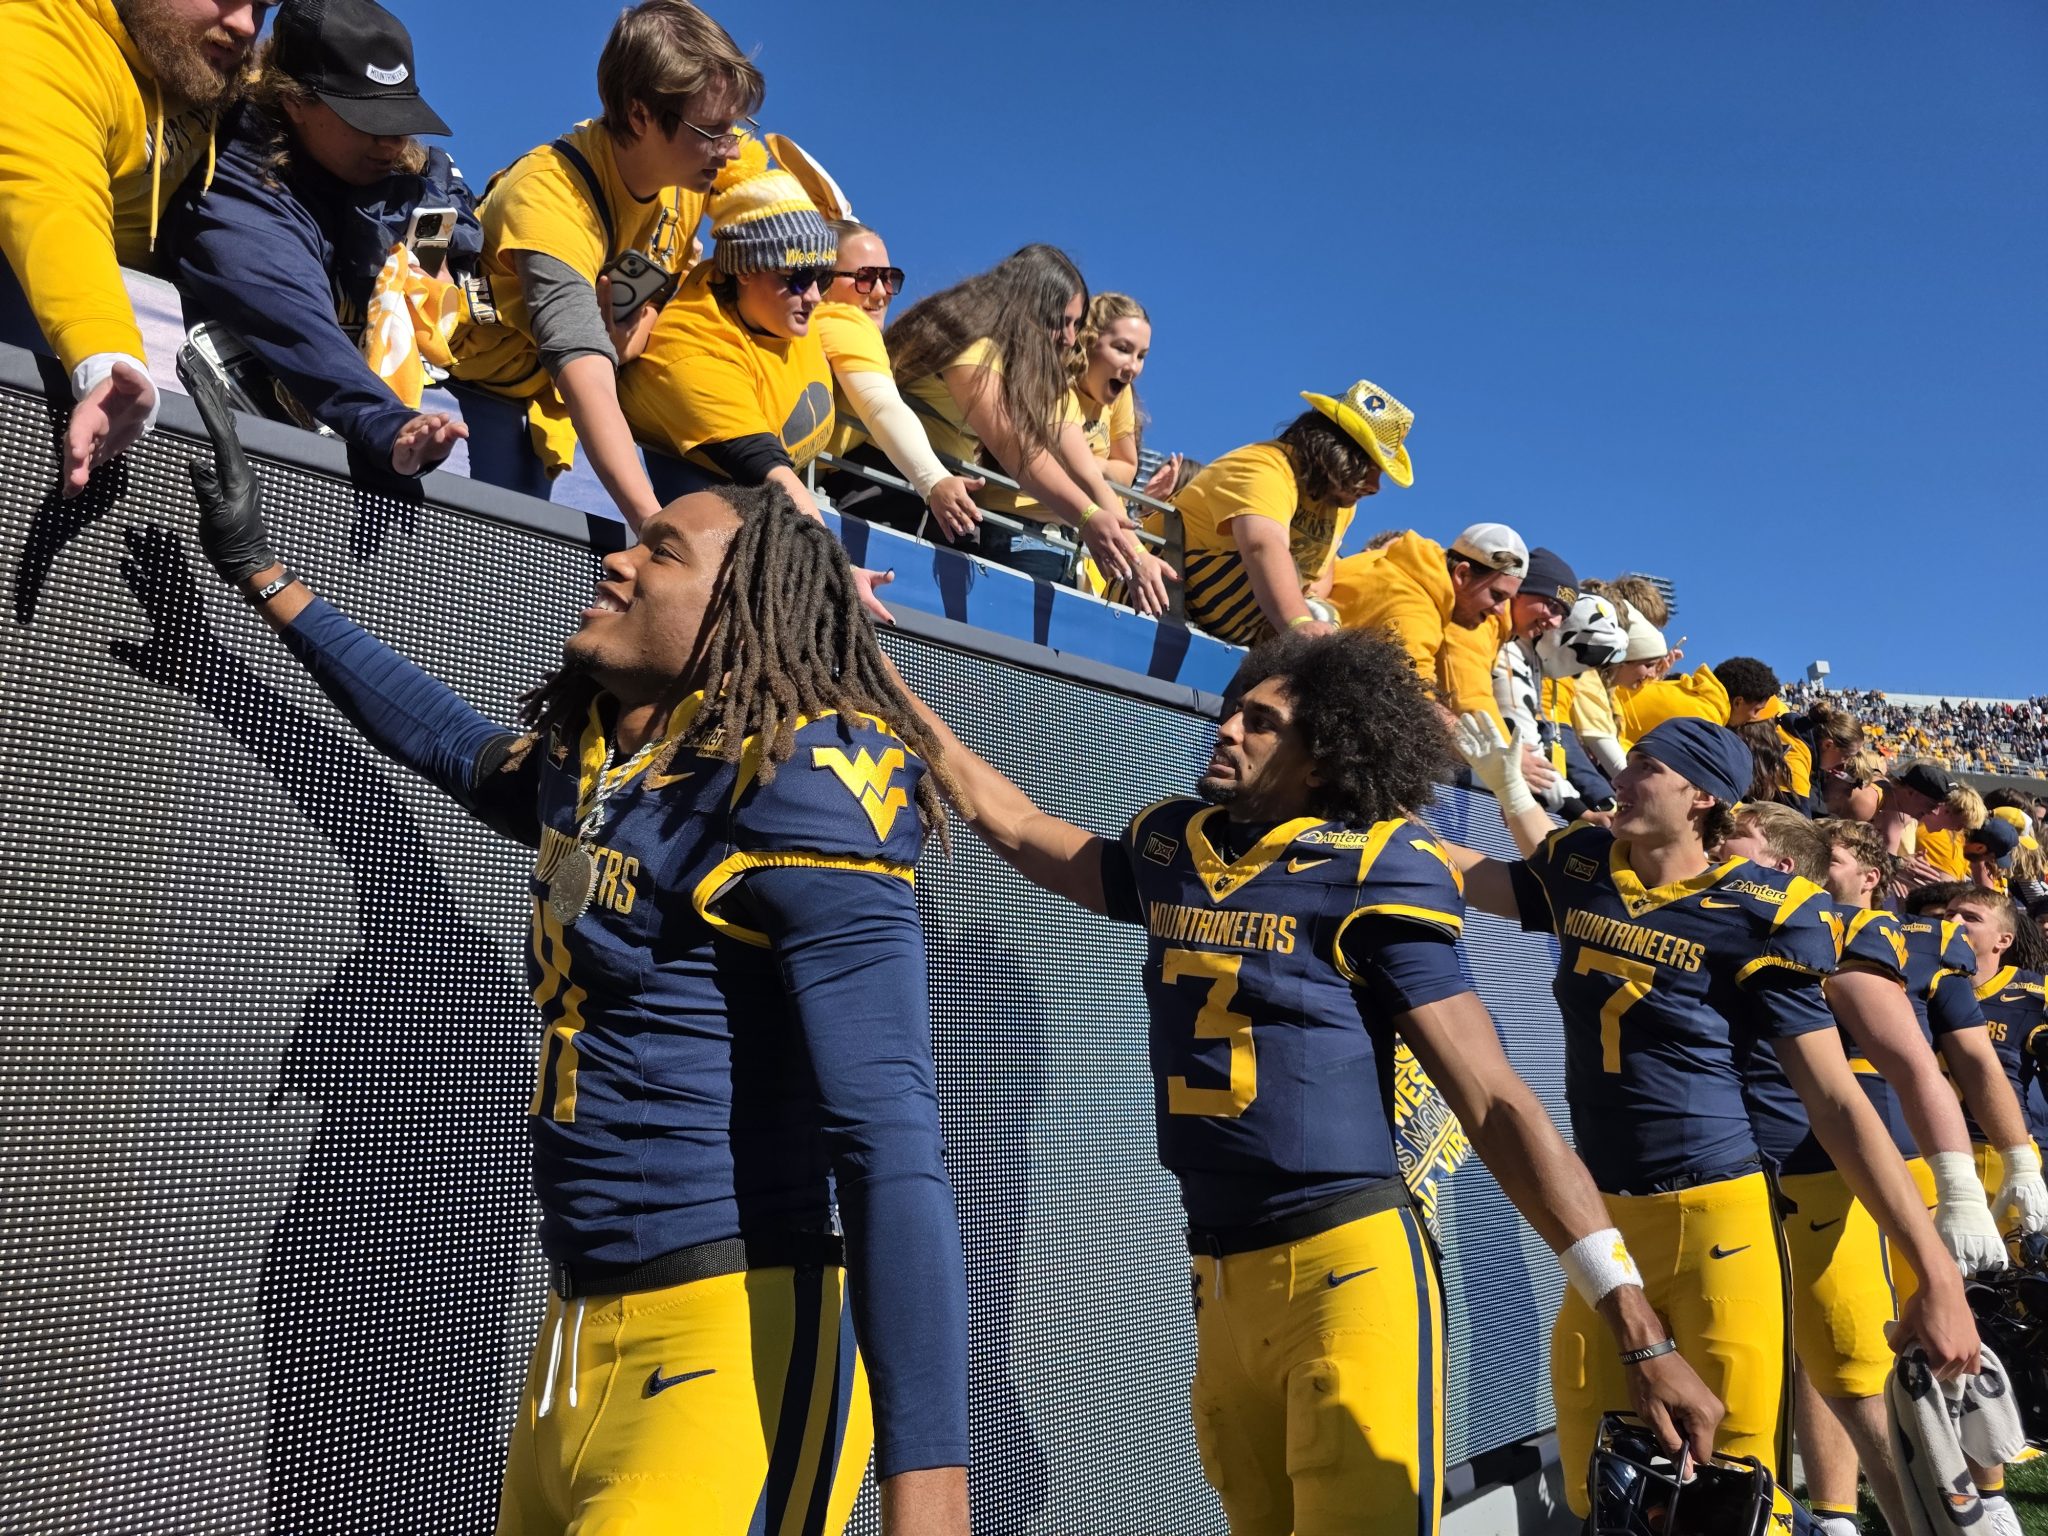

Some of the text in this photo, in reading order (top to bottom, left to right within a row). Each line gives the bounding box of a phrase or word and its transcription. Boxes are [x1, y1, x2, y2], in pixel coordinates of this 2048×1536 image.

[785, 248, 817, 267] West
[260, 581, 285, 598] FCA
[1320, 829, 1370, 844] Antero
[1741, 881, 1787, 900] Antero
[1150, 900, 1297, 955] MOUNTAINEERS
[1564, 906, 1706, 974] MOUNTAINEERS
[1573, 946, 1657, 1074] 7
[1162, 948, 1257, 1118] 3
[1634, 1349, 1653, 1360] DAY
